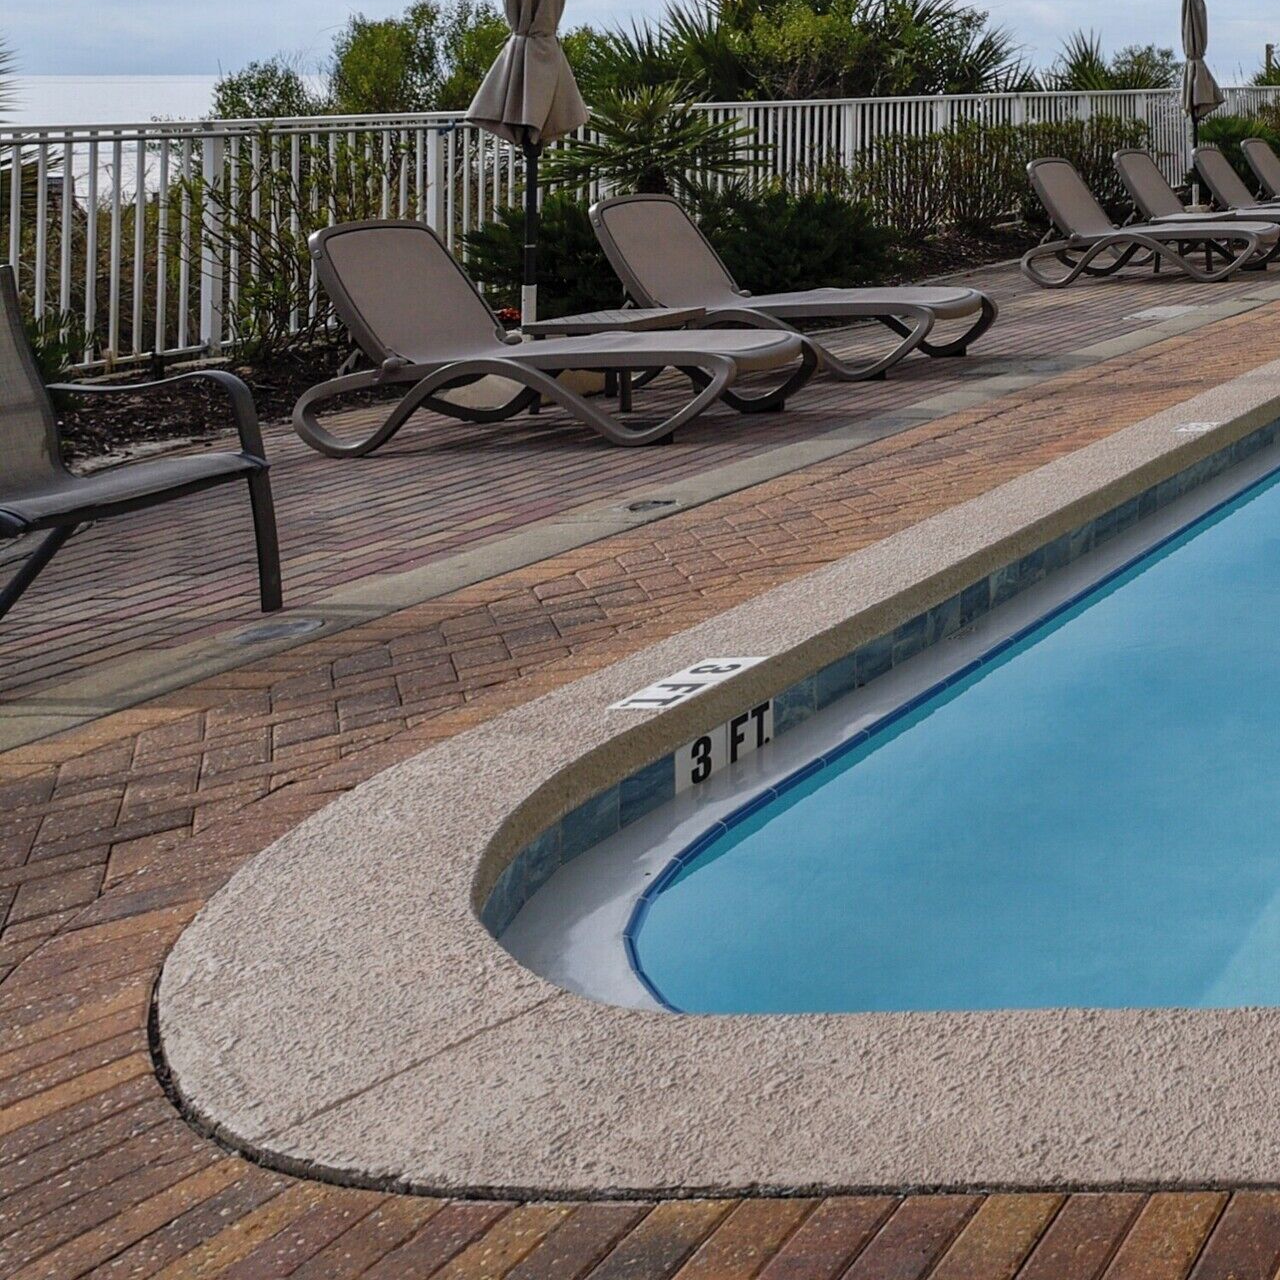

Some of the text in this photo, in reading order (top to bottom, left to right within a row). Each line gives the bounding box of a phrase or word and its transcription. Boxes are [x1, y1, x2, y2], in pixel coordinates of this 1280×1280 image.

[689, 663, 742, 675] 3
[690, 700, 770, 785] 3 FT.
